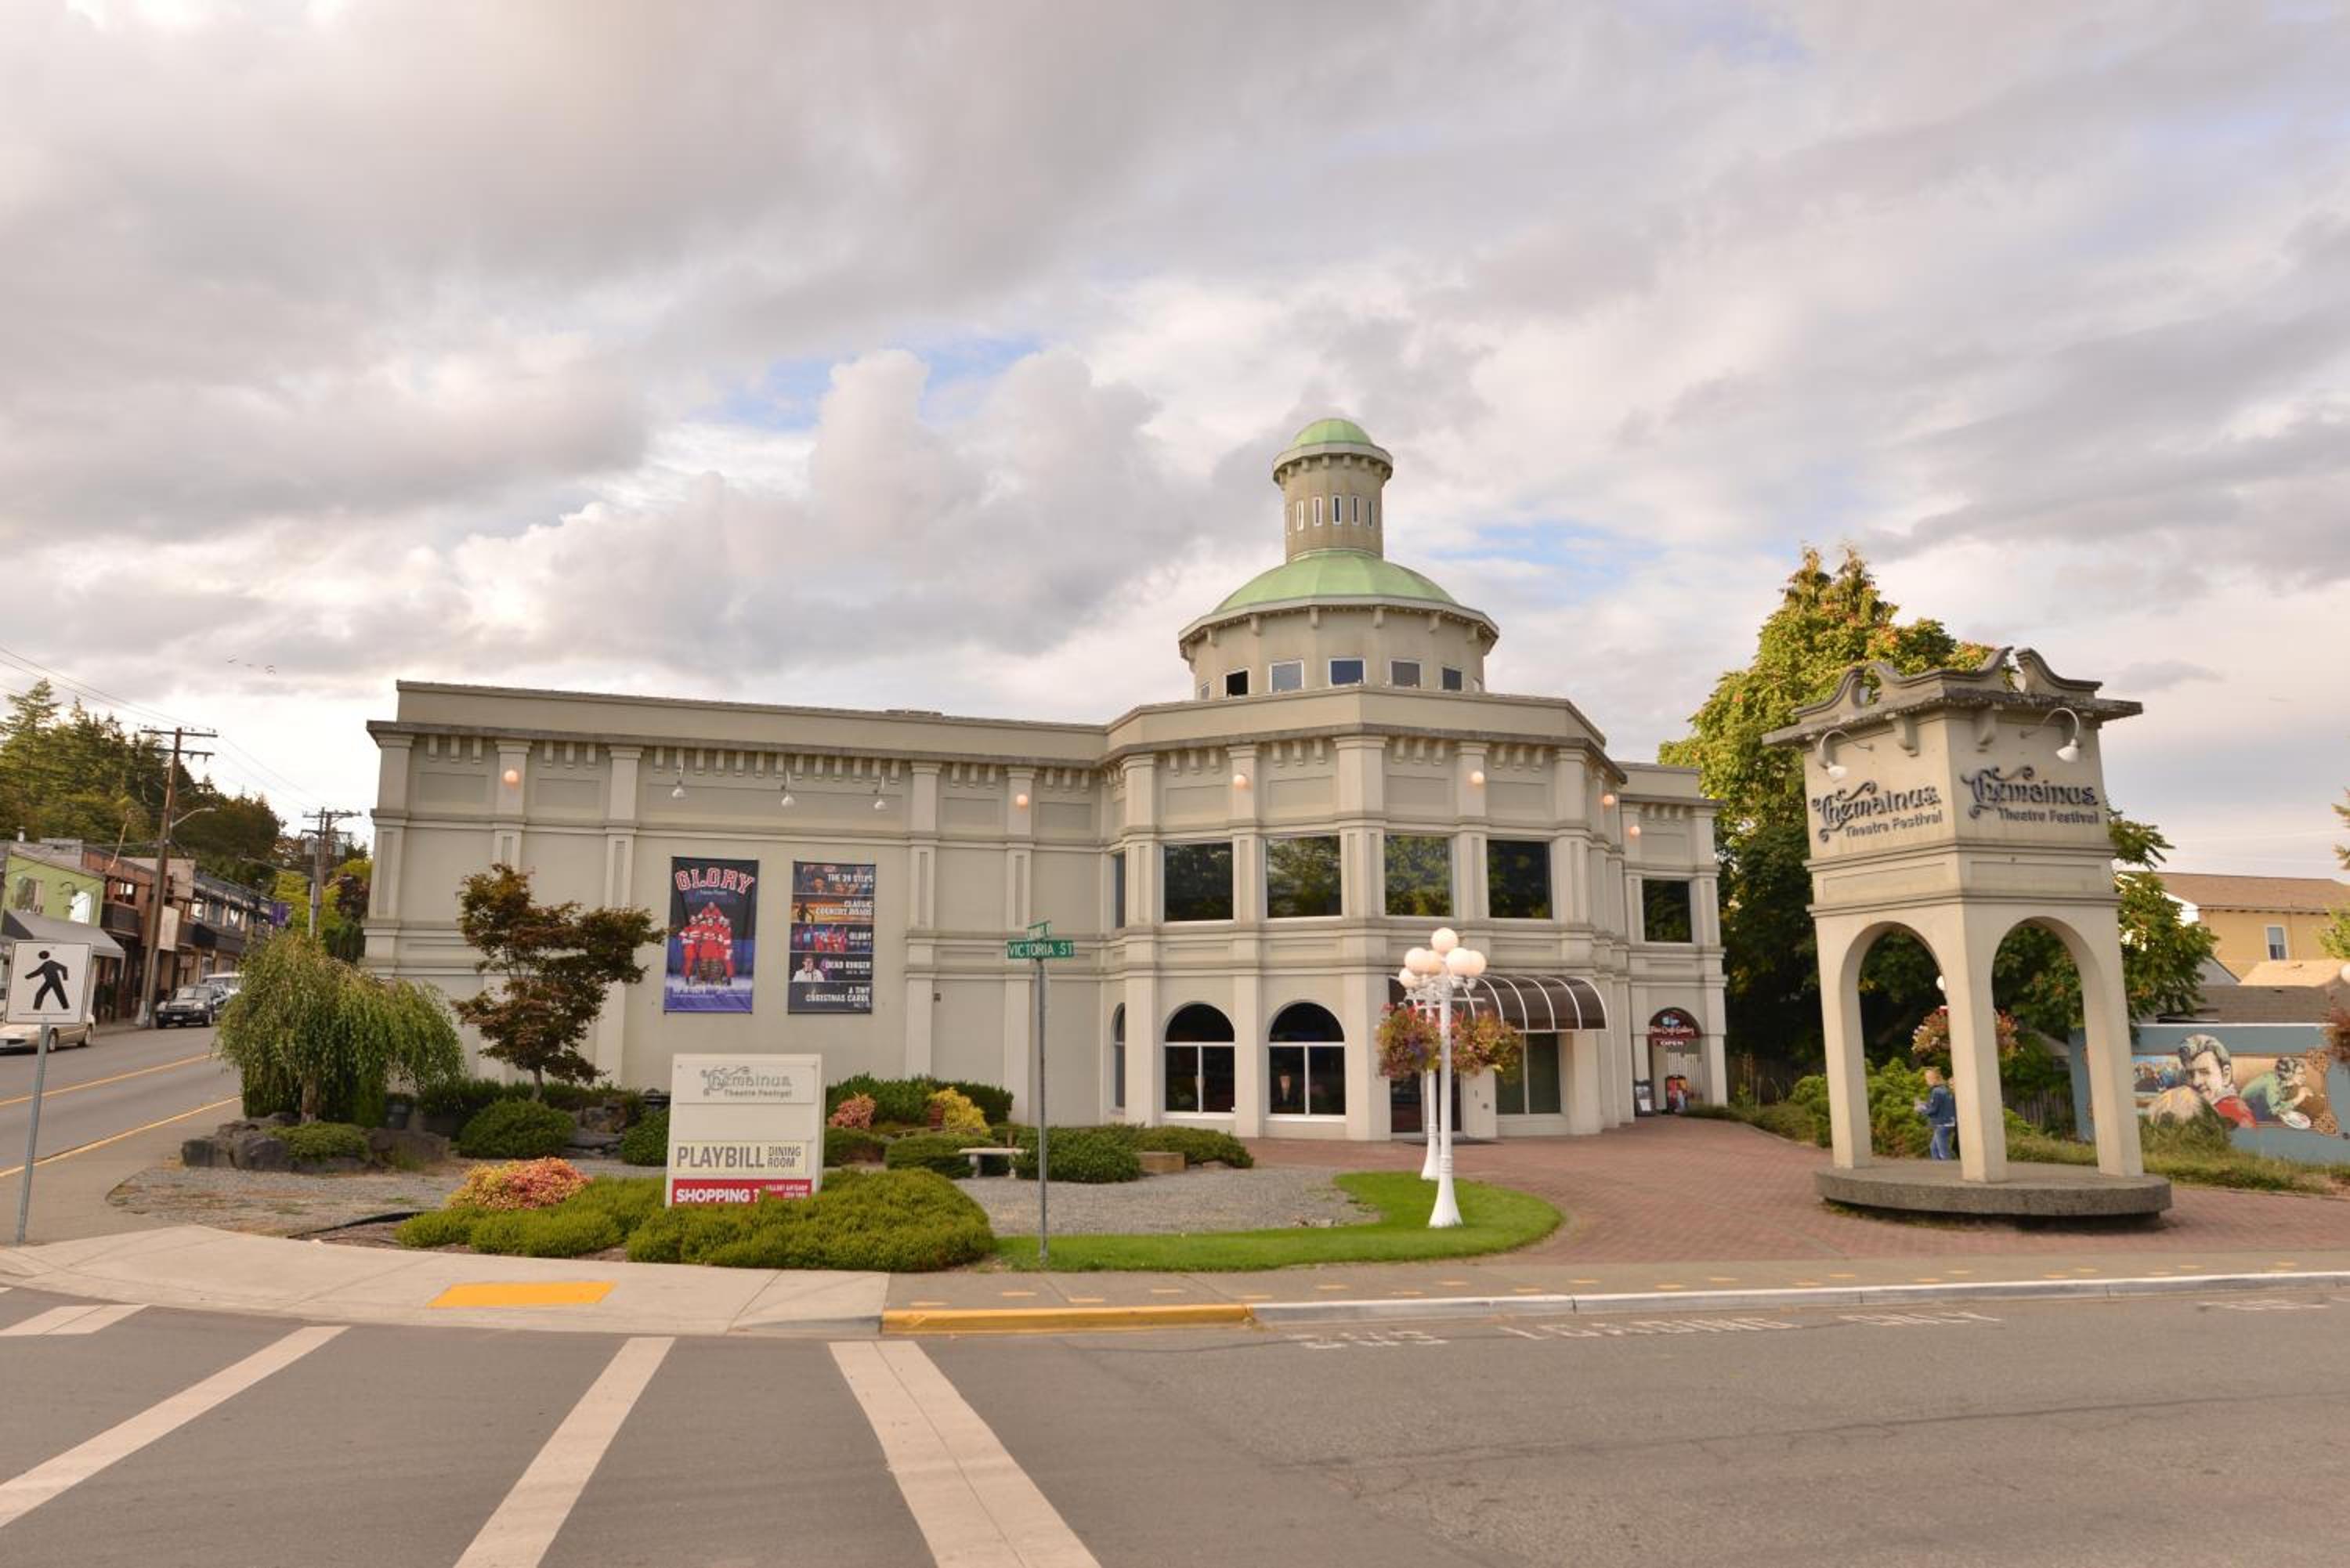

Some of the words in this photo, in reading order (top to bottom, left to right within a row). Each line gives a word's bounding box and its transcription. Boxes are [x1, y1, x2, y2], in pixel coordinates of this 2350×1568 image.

[1845, 822, 1889, 838] Theatre
[1892, 809, 1943, 830] Festival
[1998, 807, 2046, 822] Theatre
[2049, 810, 2099, 826] Festival
[674, 866, 755, 894] GLORY
[1008, 942, 1054, 956] VICTORIA
[1059, 942, 1073, 956] ST
[805, 993, 845, 1002] CHRISTMAS
[676, 1146, 765, 1169] PLAYBILL
[768, 1146, 801, 1158] DINING
[767, 1158, 796, 1168] ROOM
[675, 1188, 750, 1204] SHOPPING
